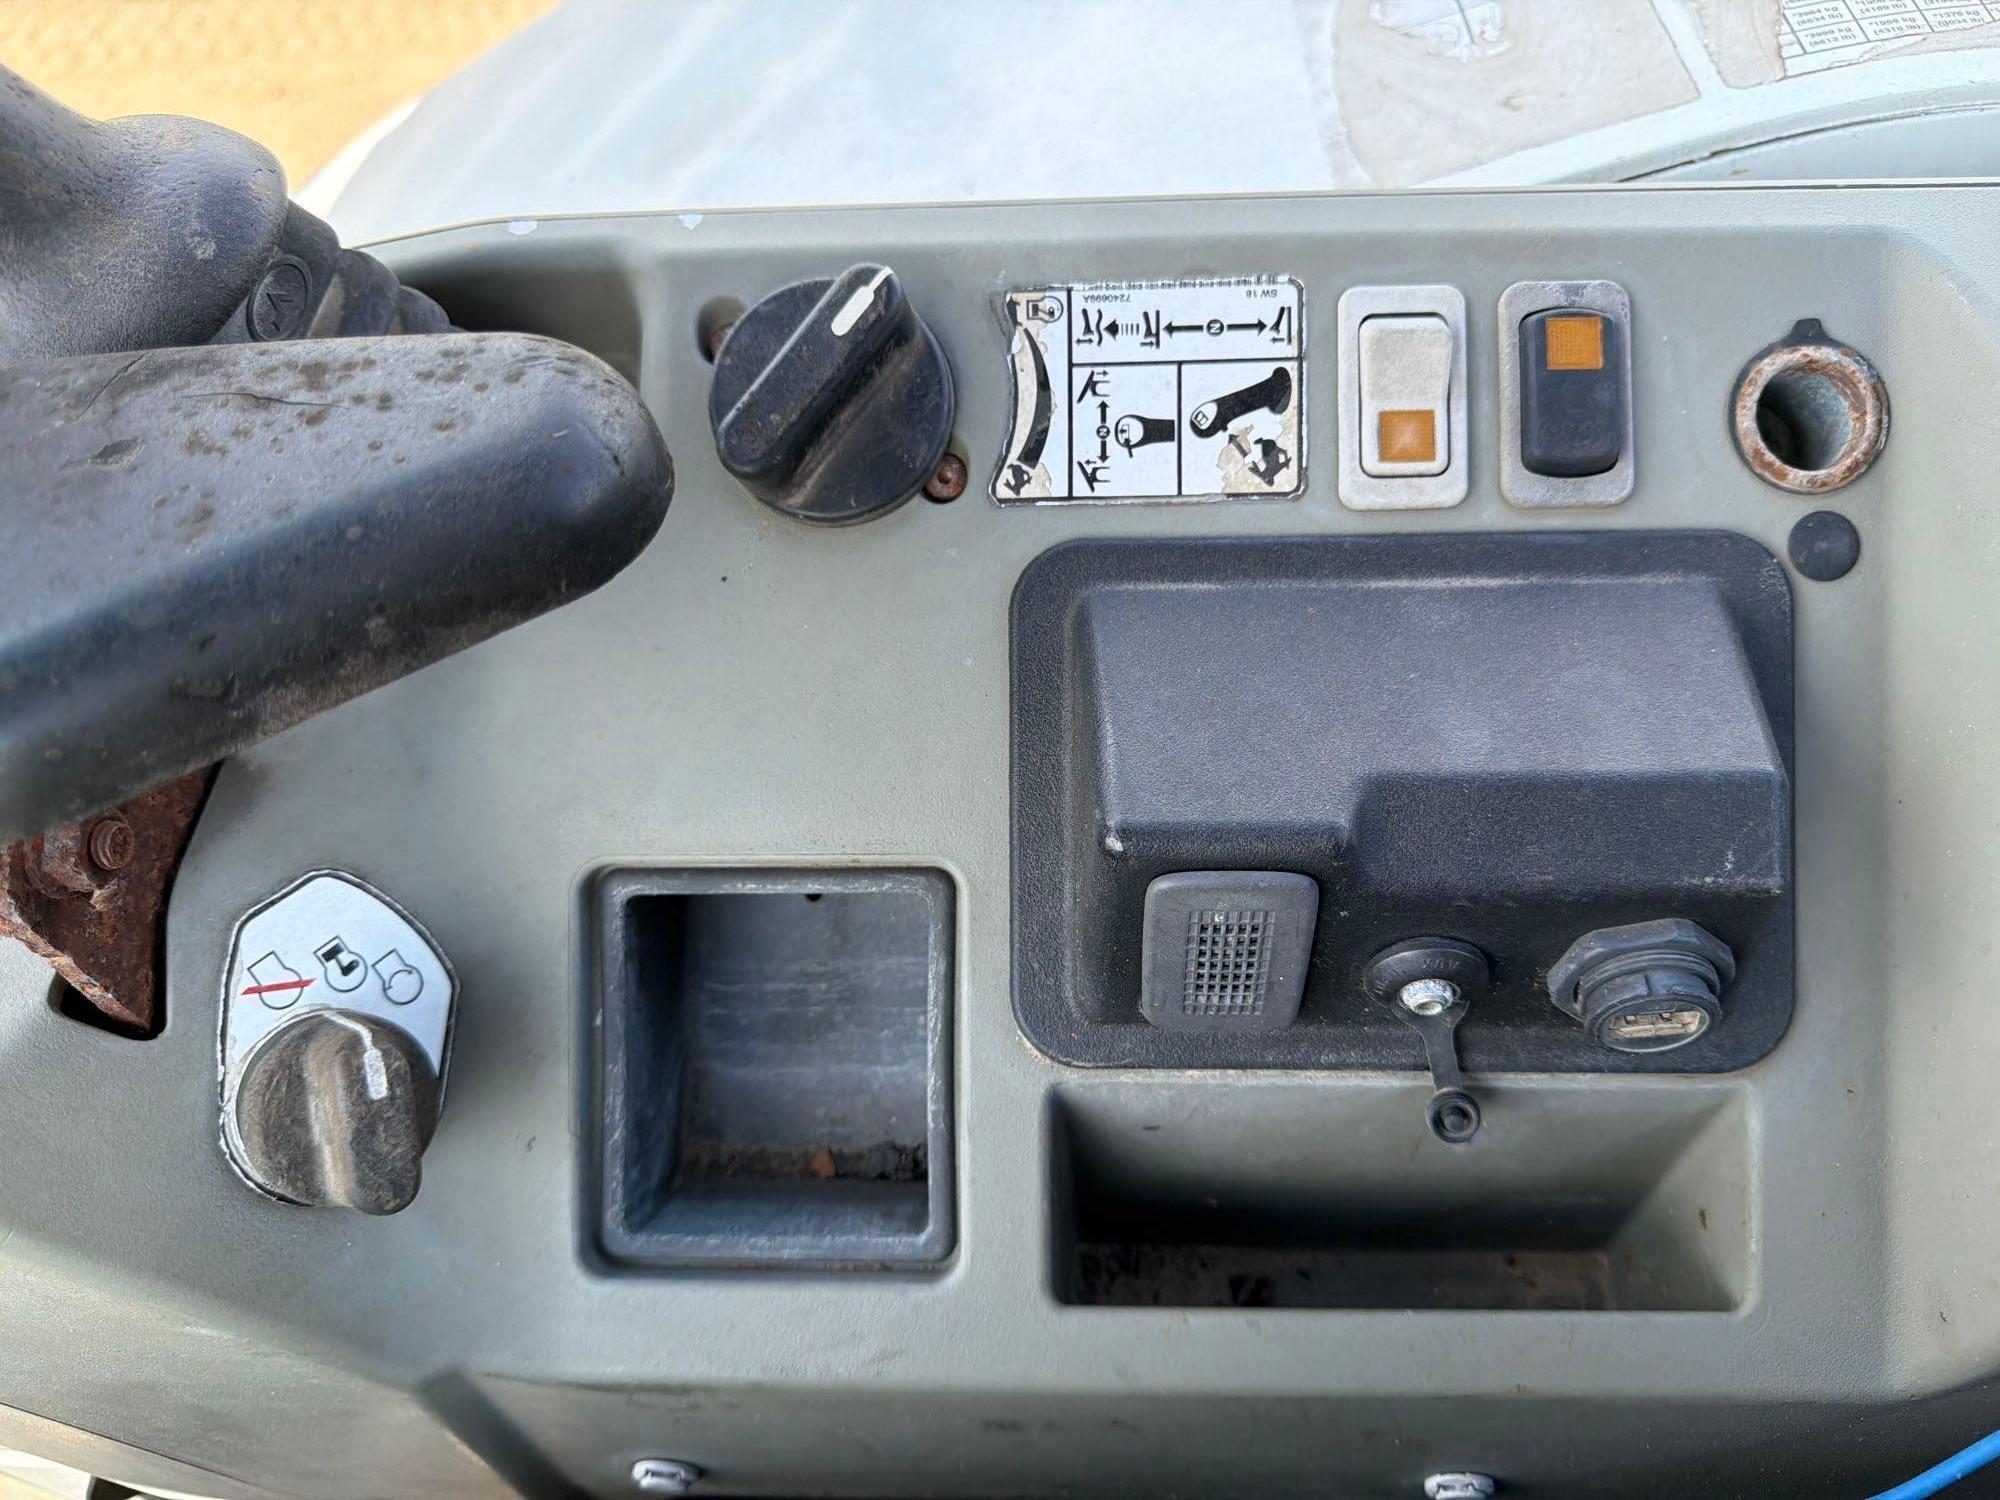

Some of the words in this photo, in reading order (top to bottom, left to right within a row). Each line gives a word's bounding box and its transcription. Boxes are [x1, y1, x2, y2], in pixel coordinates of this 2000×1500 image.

[1246, 290, 1257, 298] 18
[1261, 290, 1277, 298] SW
[1423, 958, 1459, 970] AUX
